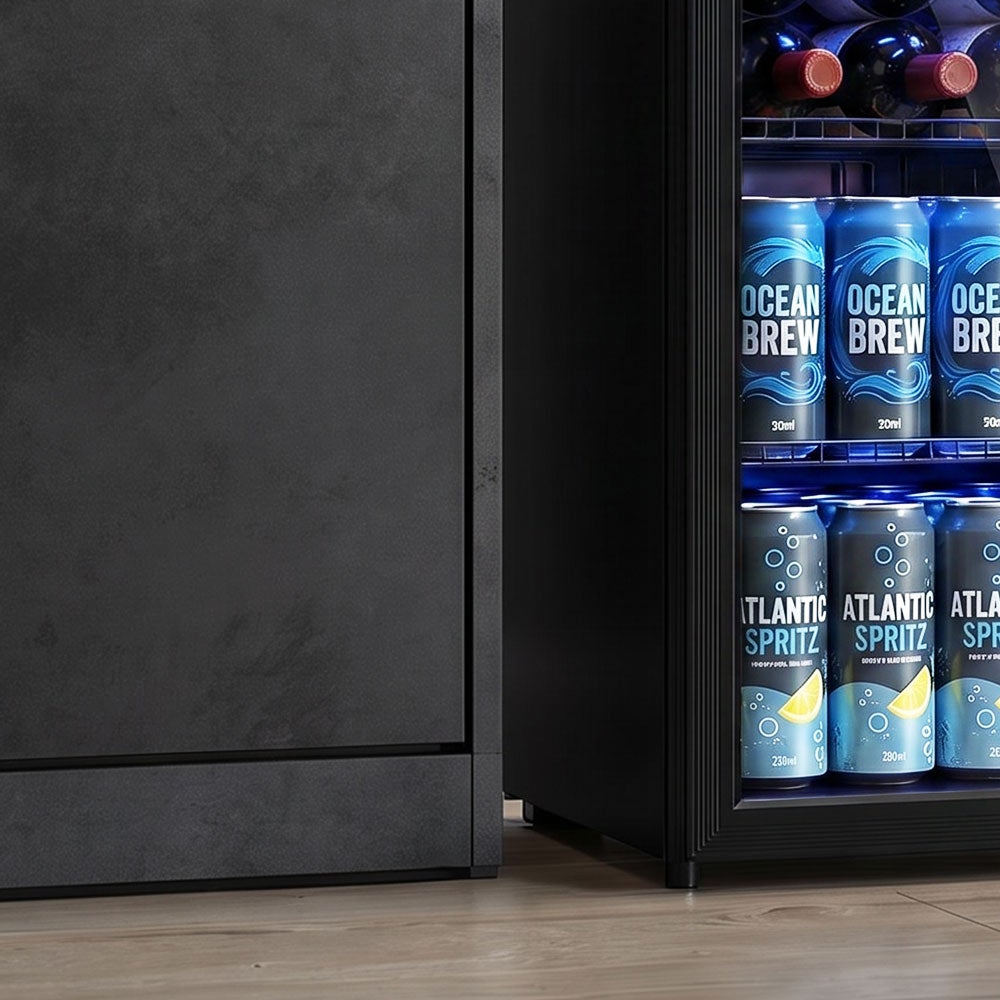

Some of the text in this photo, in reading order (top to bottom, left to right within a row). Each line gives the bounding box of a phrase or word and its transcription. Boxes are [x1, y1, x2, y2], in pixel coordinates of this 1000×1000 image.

[741, 284, 820, 317] OCEAN
[847, 283, 926, 315] OCEAN
[742, 319, 820, 356] BREW
[849, 317, 926, 354] BREW
[842, 590, 934, 621] ATLANTIC
[745, 626, 820, 656] SPRITZ
[855, 622, 928, 651] SPRITZ
